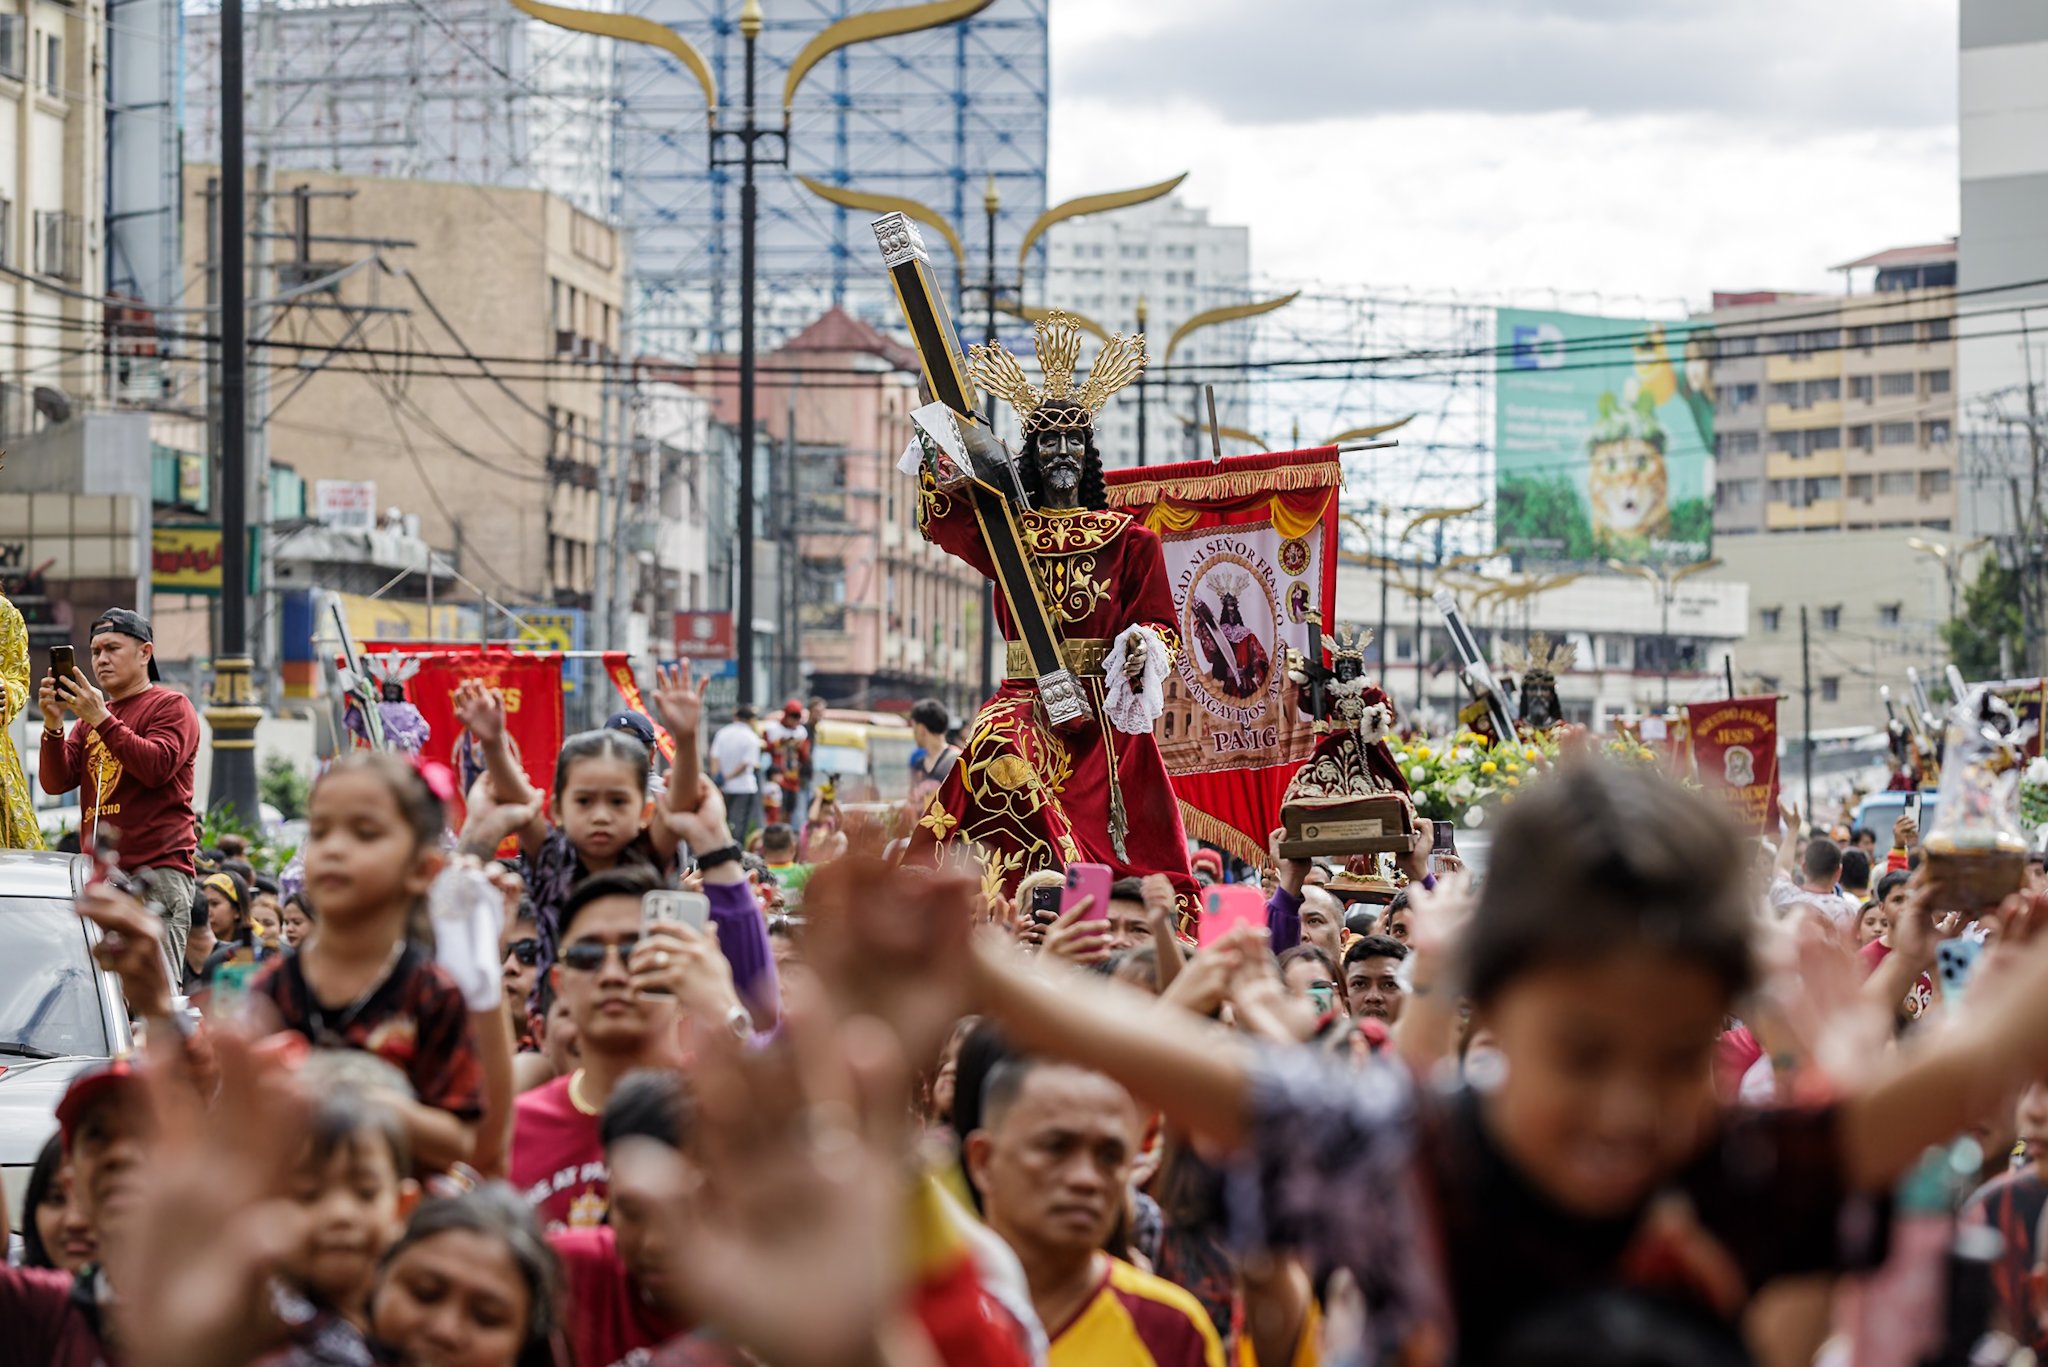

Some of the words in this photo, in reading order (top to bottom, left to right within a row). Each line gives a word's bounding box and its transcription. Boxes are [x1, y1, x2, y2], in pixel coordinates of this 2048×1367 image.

[1189, 549, 1206, 569] NI
[1206, 537, 1256, 562] SEÑOR
[1256, 557, 1284, 626] FRANCO
[1179, 654, 1234, 719] BALANGAY
[1716, 728, 1754, 744] JESUS
